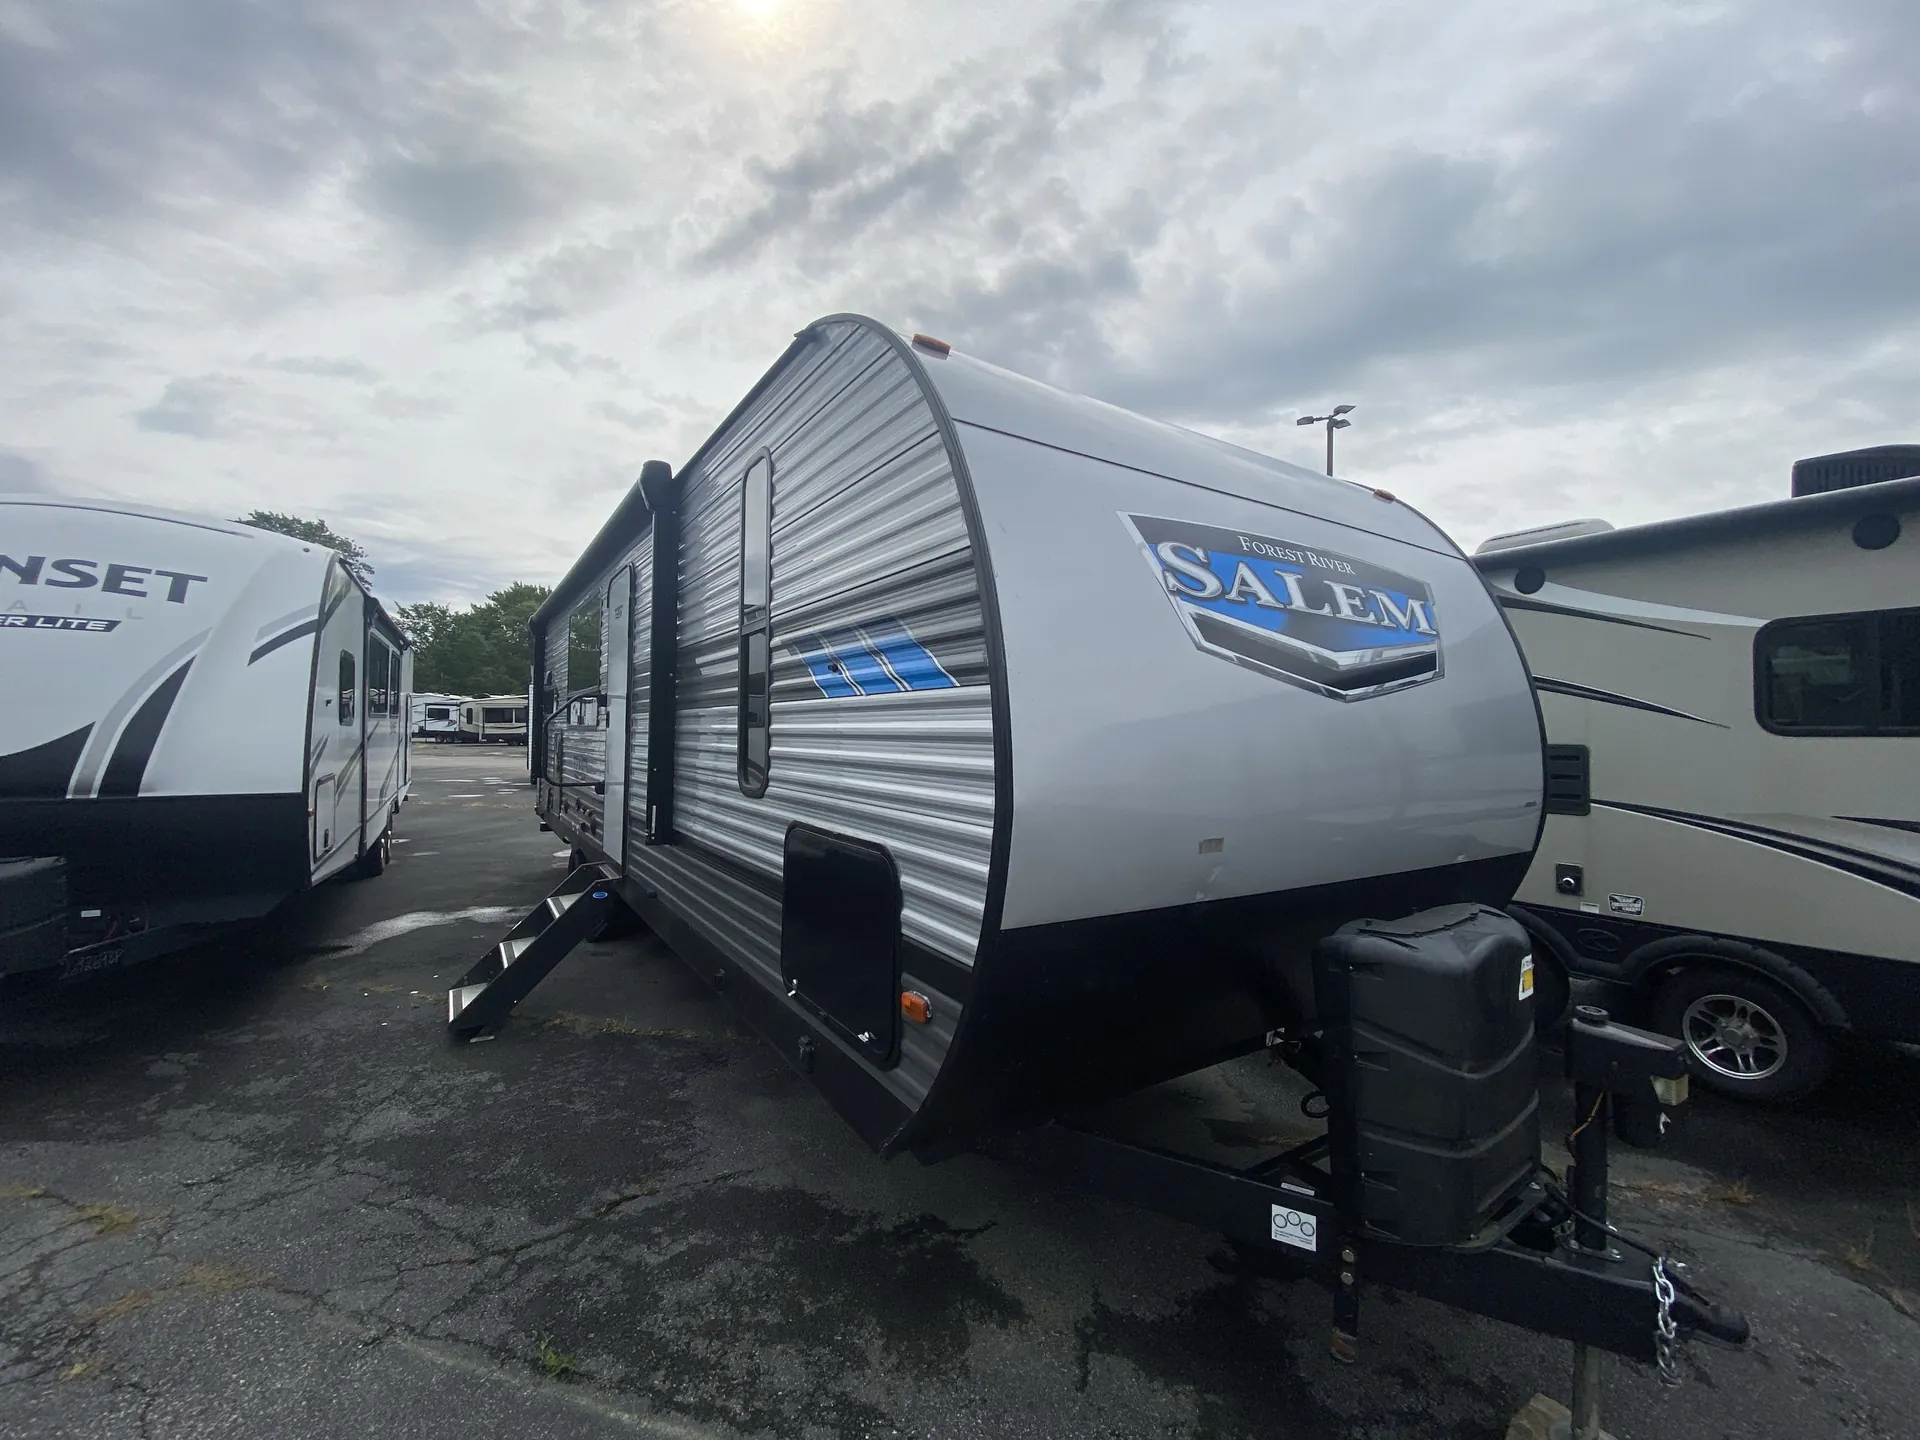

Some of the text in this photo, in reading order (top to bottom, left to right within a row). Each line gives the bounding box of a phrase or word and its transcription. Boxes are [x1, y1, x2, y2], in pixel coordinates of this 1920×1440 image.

[1237, 535, 1356, 575] FOREST RIVER
[0, 555, 208, 604] NSET
[1157, 542, 1438, 635] SALEM
[0, 616, 109, 630] R LITE
